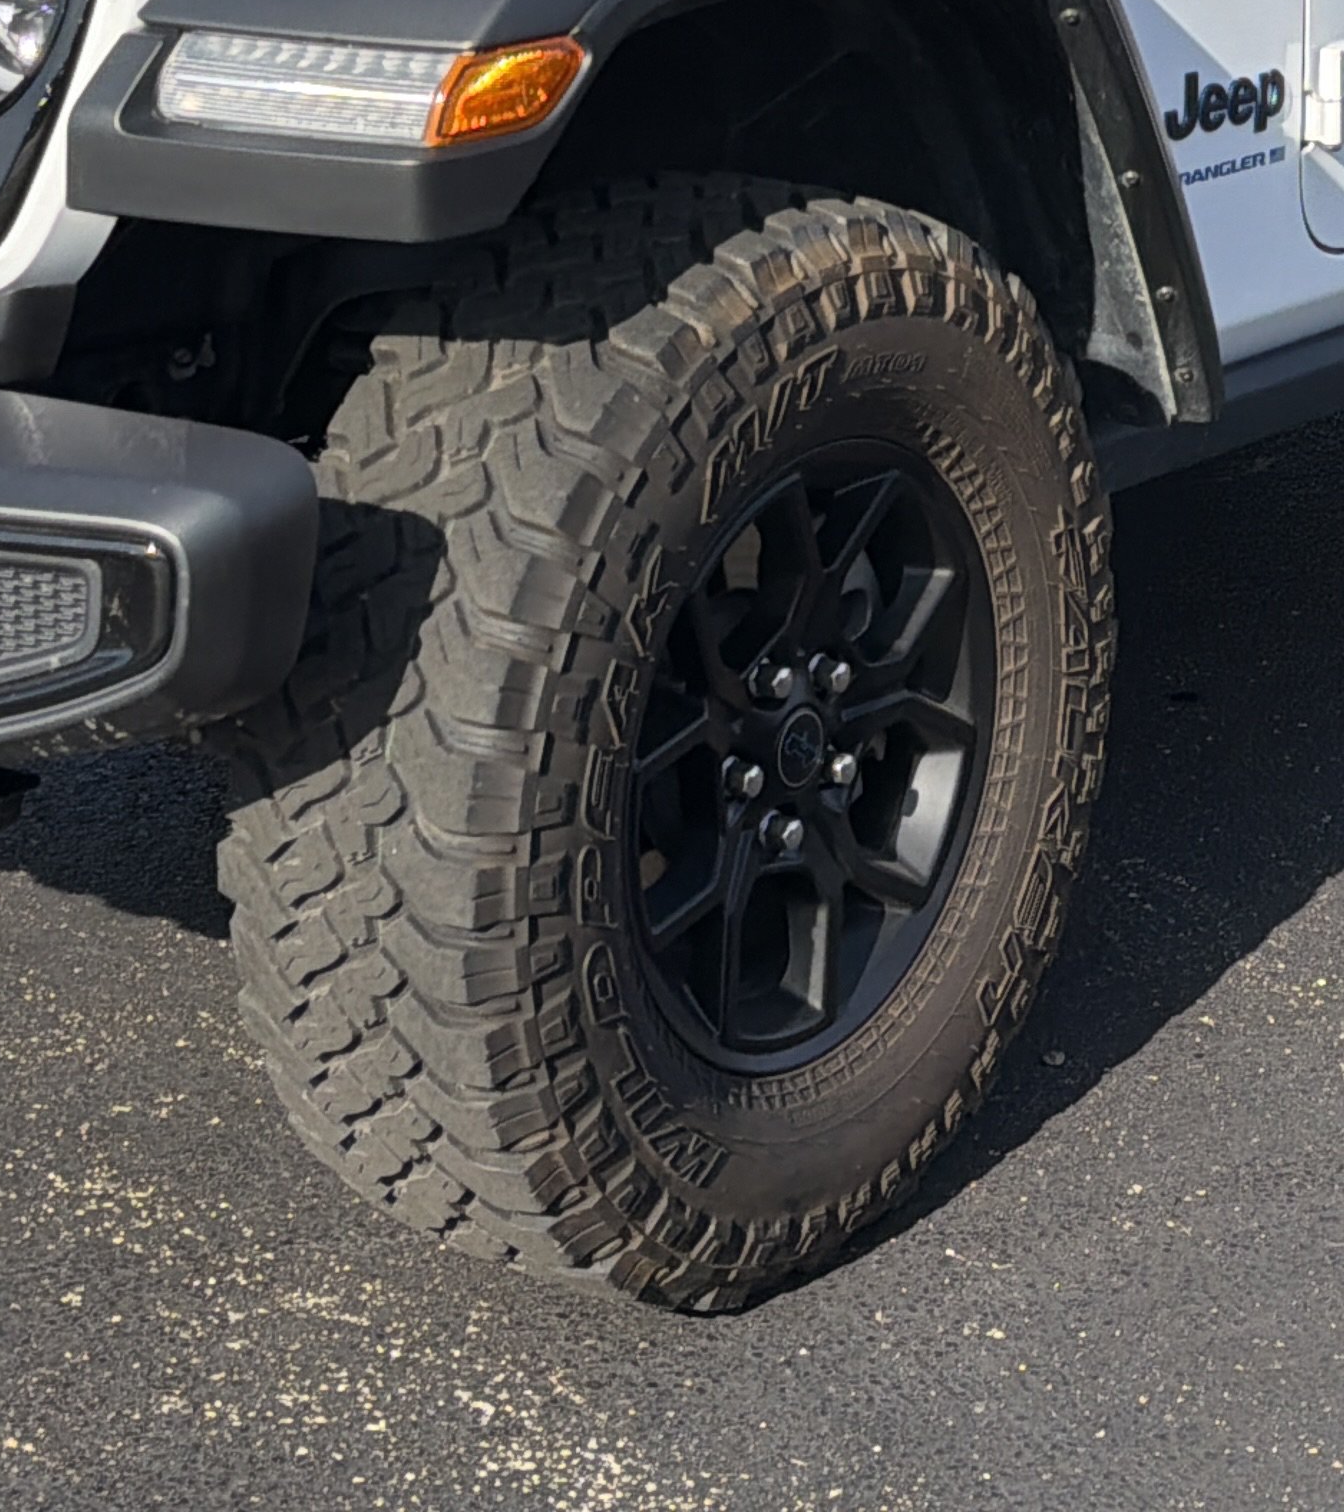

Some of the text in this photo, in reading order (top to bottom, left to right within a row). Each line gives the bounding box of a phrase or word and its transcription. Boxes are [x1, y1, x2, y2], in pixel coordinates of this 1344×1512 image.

[1163, 68, 1286, 141] Jeep
[1178, 151, 1266, 186] RANGLER
[576, 544, 730, 1187] WILDPEAK
[974, 505, 1090, 1027] FALKEN
